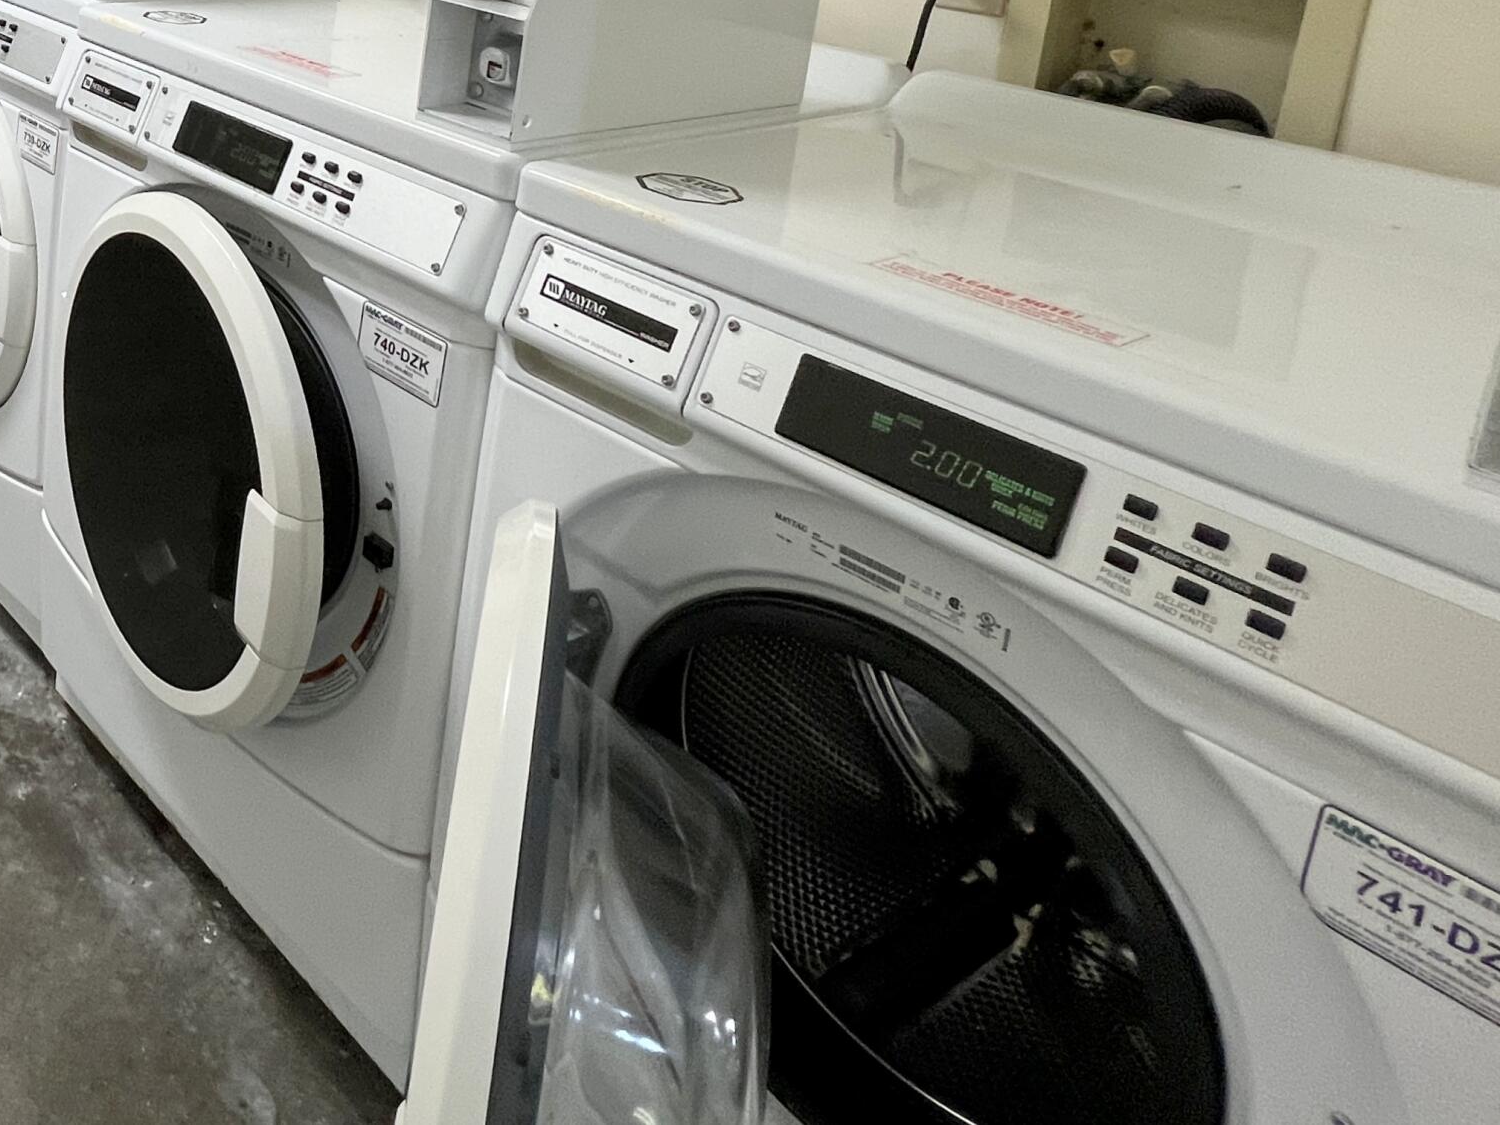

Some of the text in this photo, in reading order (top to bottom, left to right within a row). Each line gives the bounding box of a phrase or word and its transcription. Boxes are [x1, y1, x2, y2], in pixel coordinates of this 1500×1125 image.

[943, 272, 1016, 297] PLEASE
[563, 289, 608, 317] MAYTAG
[373, 332, 430, 376] 740-DZK
[910, 439, 983, 489] 2.00
[774, 512, 808, 533] MAYTAG
[1115, 512, 1158, 536] WHITES
[1181, 541, 1231, 567] COLORS
[1100, 565, 1132, 586] PERM
[1150, 545, 1253, 594] FABRIC SETTINGS
[1095, 575, 1132, 597] PRESS
[1254, 571, 1310, 601] BRIGHTS
[1152, 600, 1213, 634] AND KNITS
[1154, 590, 1218, 625] DELICATES
[1237, 639, 1279, 664] CYCLE
[1241, 631, 1280, 652] QUICK
[1325, 813, 1459, 888] MAC-GRAY
